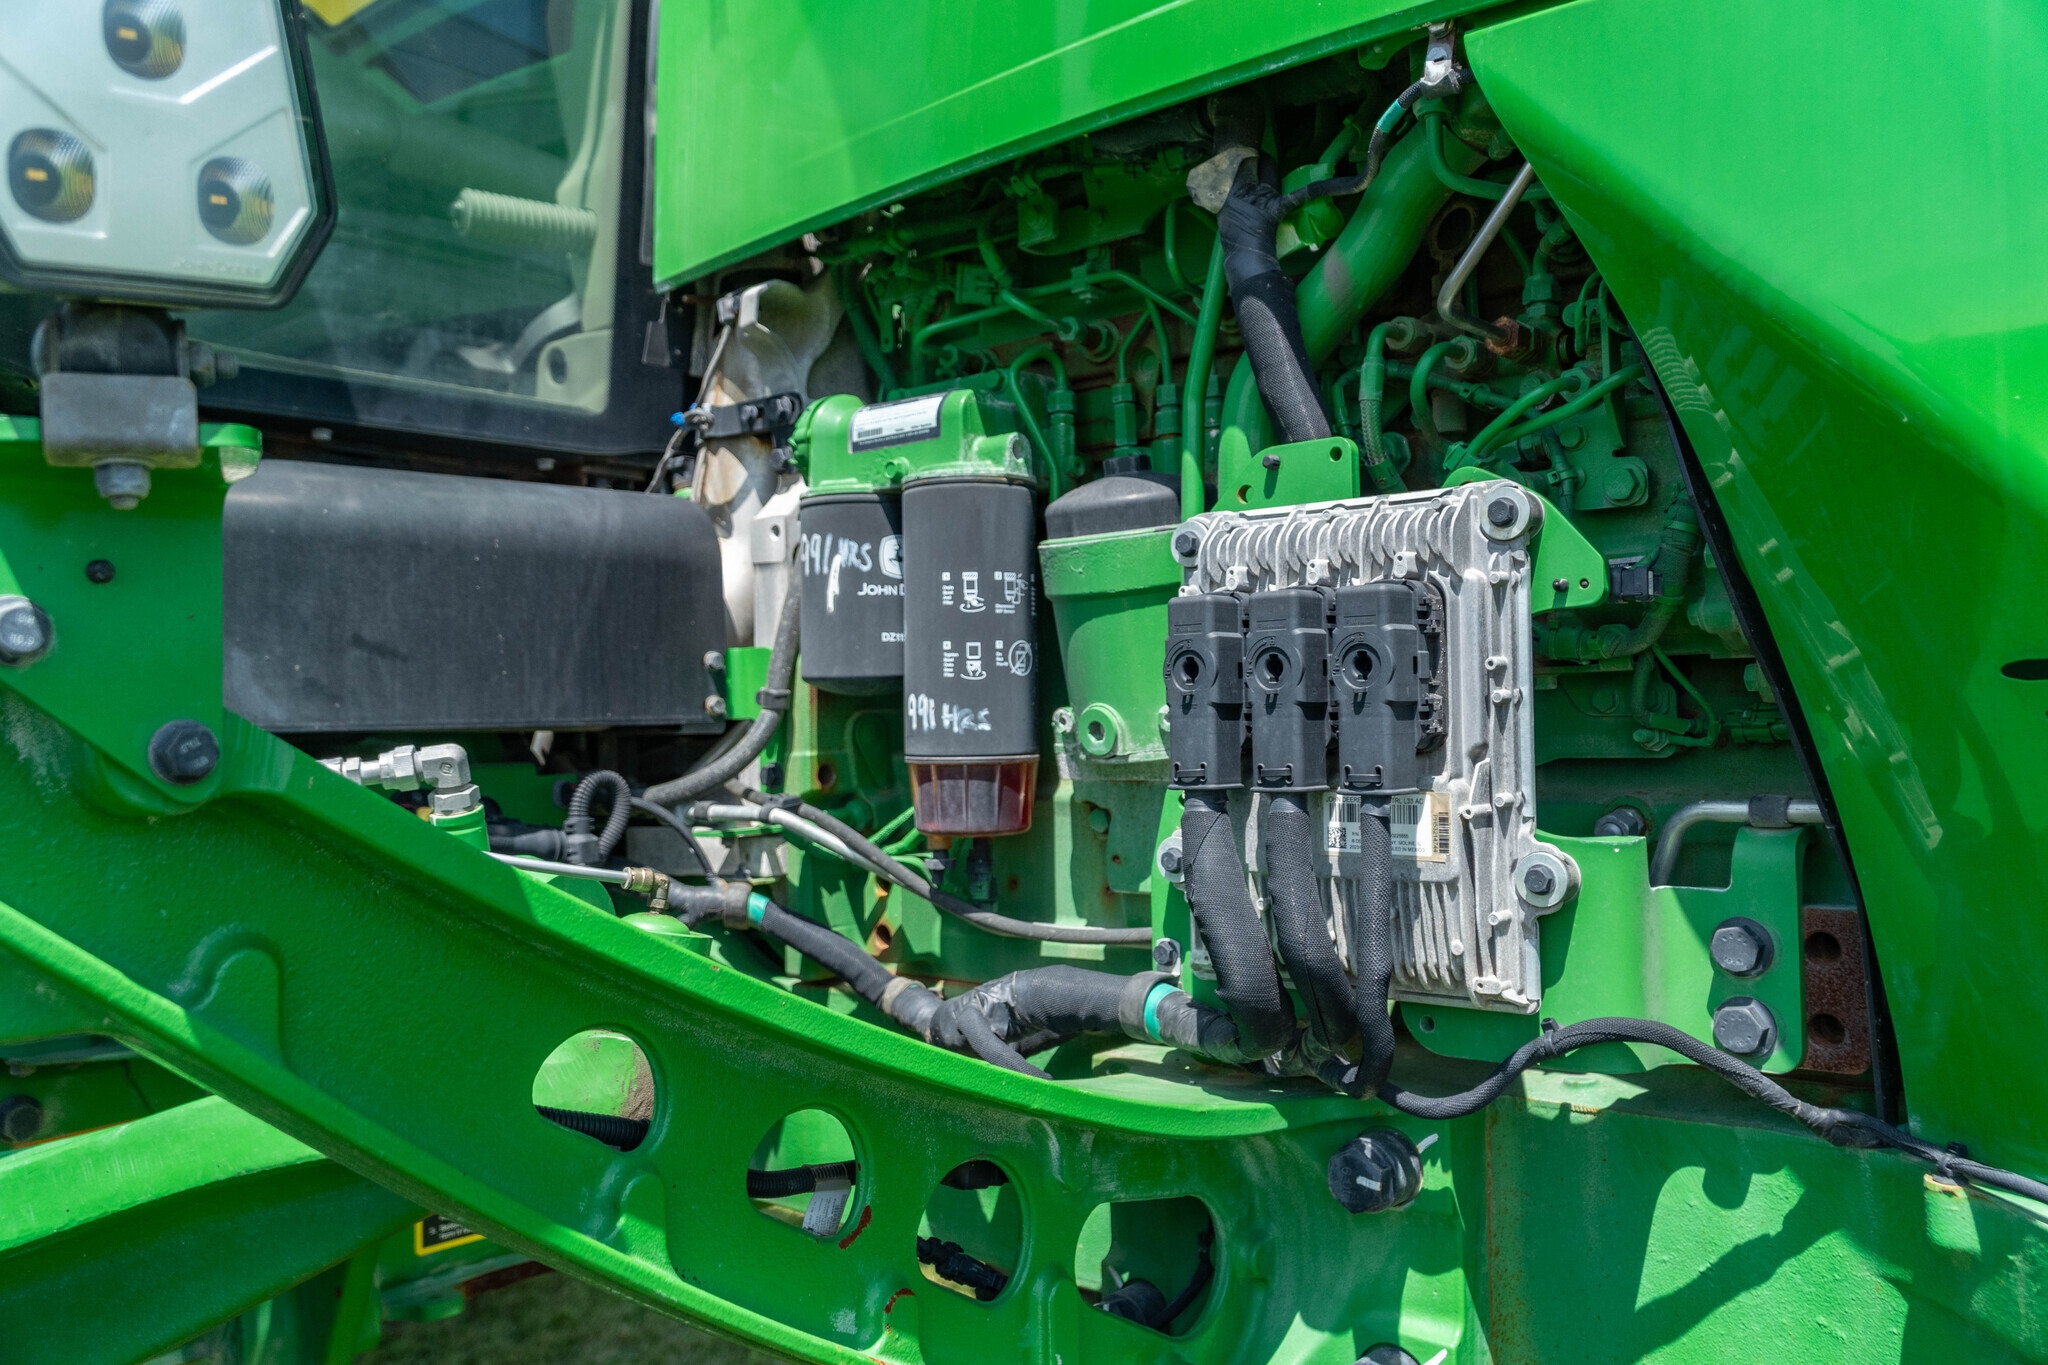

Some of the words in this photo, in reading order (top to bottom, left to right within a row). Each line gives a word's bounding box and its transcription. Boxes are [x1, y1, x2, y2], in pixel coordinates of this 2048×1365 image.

[857, 582, 898, 596] JOHN
[908, 693, 936, 732] 991
[941, 702, 992, 735] HRS
